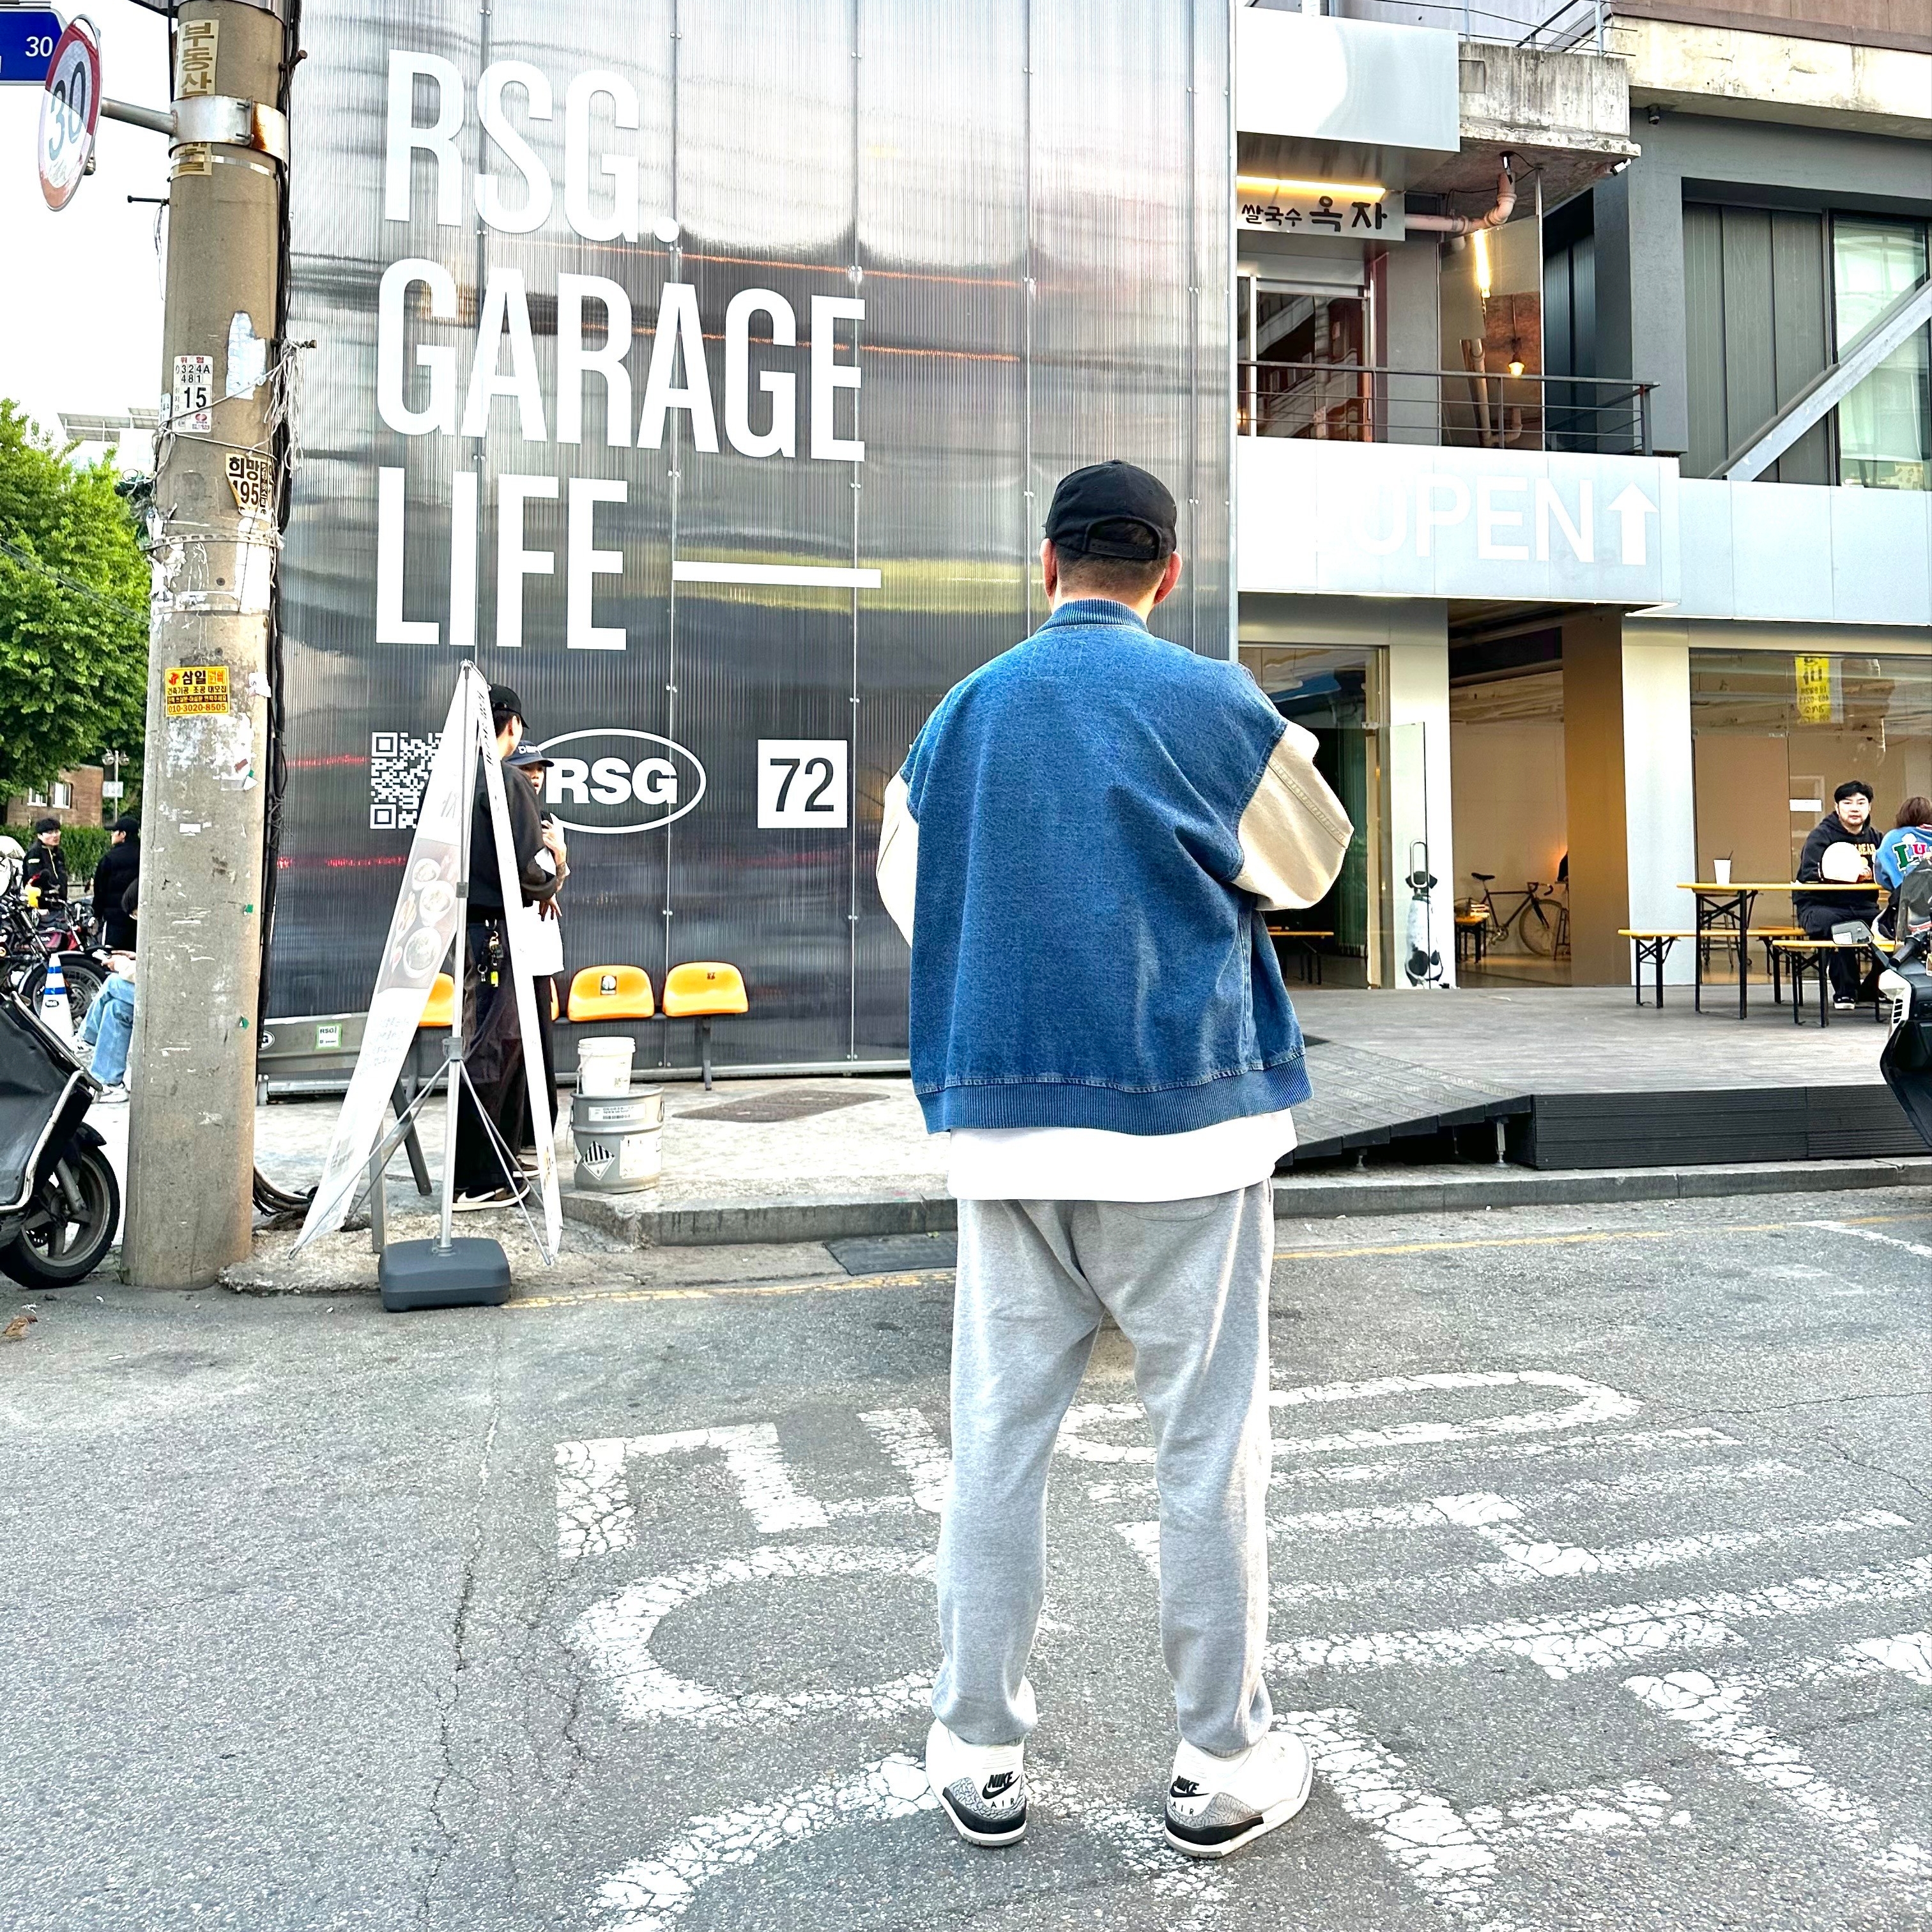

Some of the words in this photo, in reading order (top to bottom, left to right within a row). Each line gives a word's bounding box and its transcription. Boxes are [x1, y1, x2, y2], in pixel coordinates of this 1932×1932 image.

[25, 36, 53, 57] 30
[49, 60, 86, 162] 30
[384, 49, 680, 243] RSG.
[1241, 203, 1303, 227] 쌀국수
[1309, 195, 1388, 233] 옥자
[376, 257, 866, 462] GARAGE
[181, 374, 201, 383] 481
[184, 387, 207, 409] 15
[229, 456, 260, 481] 희망
[1348, 473, 1595, 563] OPEN
[376, 466, 628, 651] LIFE
[181, 670, 206, 686] 삼일
[168, 703, 226, 713] 010-3020-8505
[544, 757, 678, 805] RSG
[769, 758, 834, 813] 72
[987, 1770, 1014, 1789] NIKE
[1174, 1775, 1200, 1794] NIKE
[990, 1797, 1015, 1808] AIR
[1171, 1801, 1195, 1816] AIR
